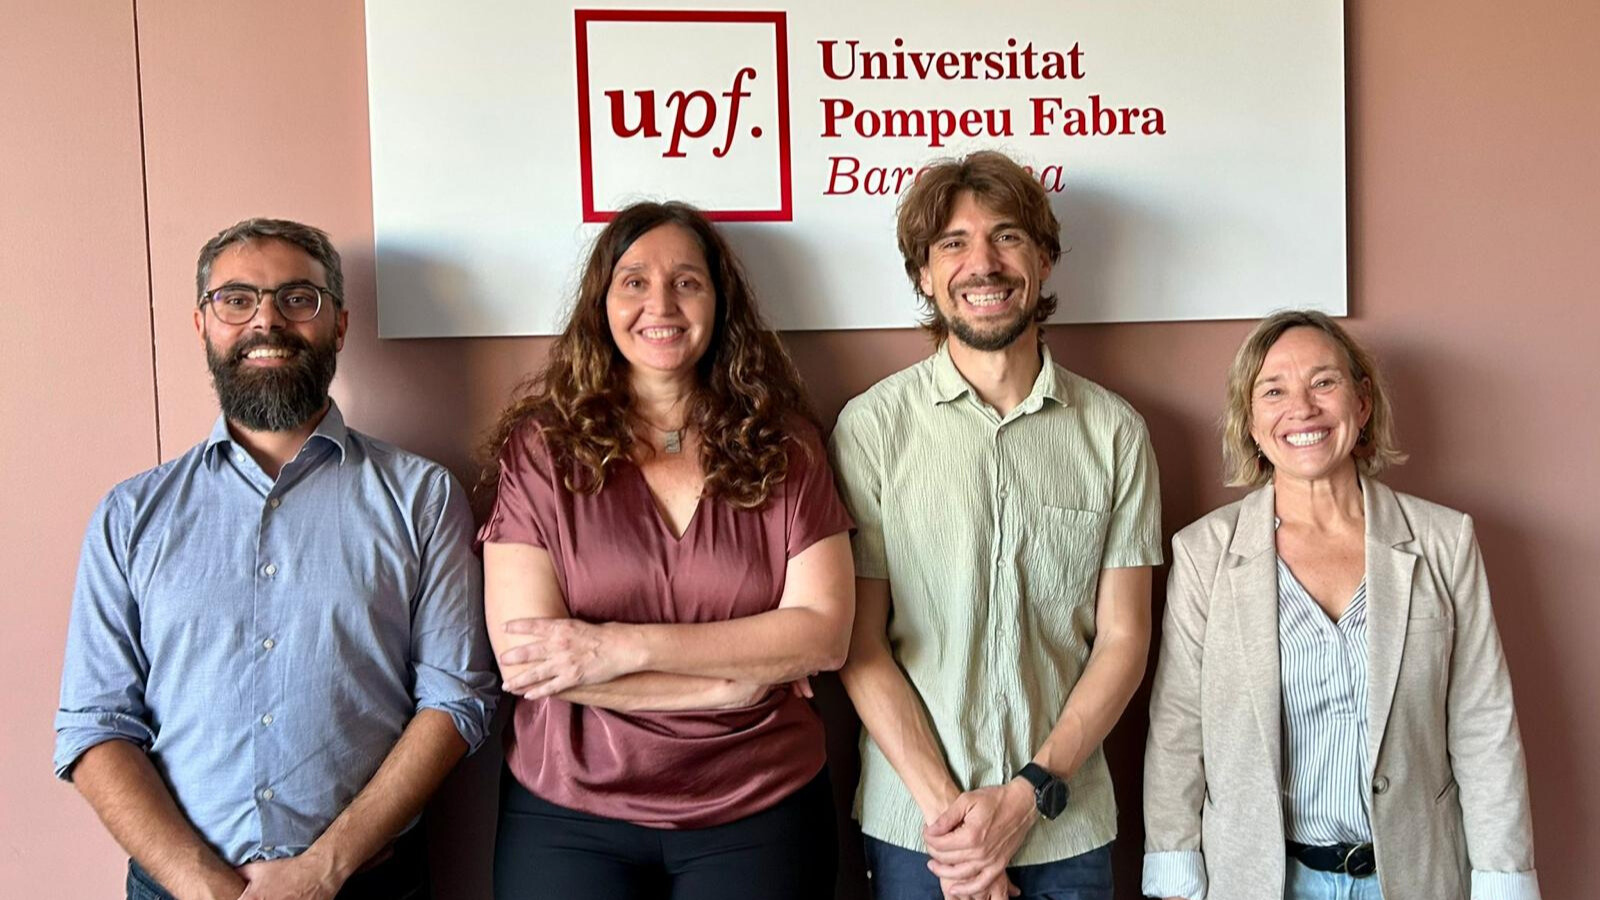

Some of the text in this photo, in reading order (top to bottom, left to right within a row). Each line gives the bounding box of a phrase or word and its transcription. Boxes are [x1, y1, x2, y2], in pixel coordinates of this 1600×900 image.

[817, 38, 1086, 81] Universitat
[604, 67, 763, 158] upf.
[820, 95, 1167, 148] Pompeu Fabra
